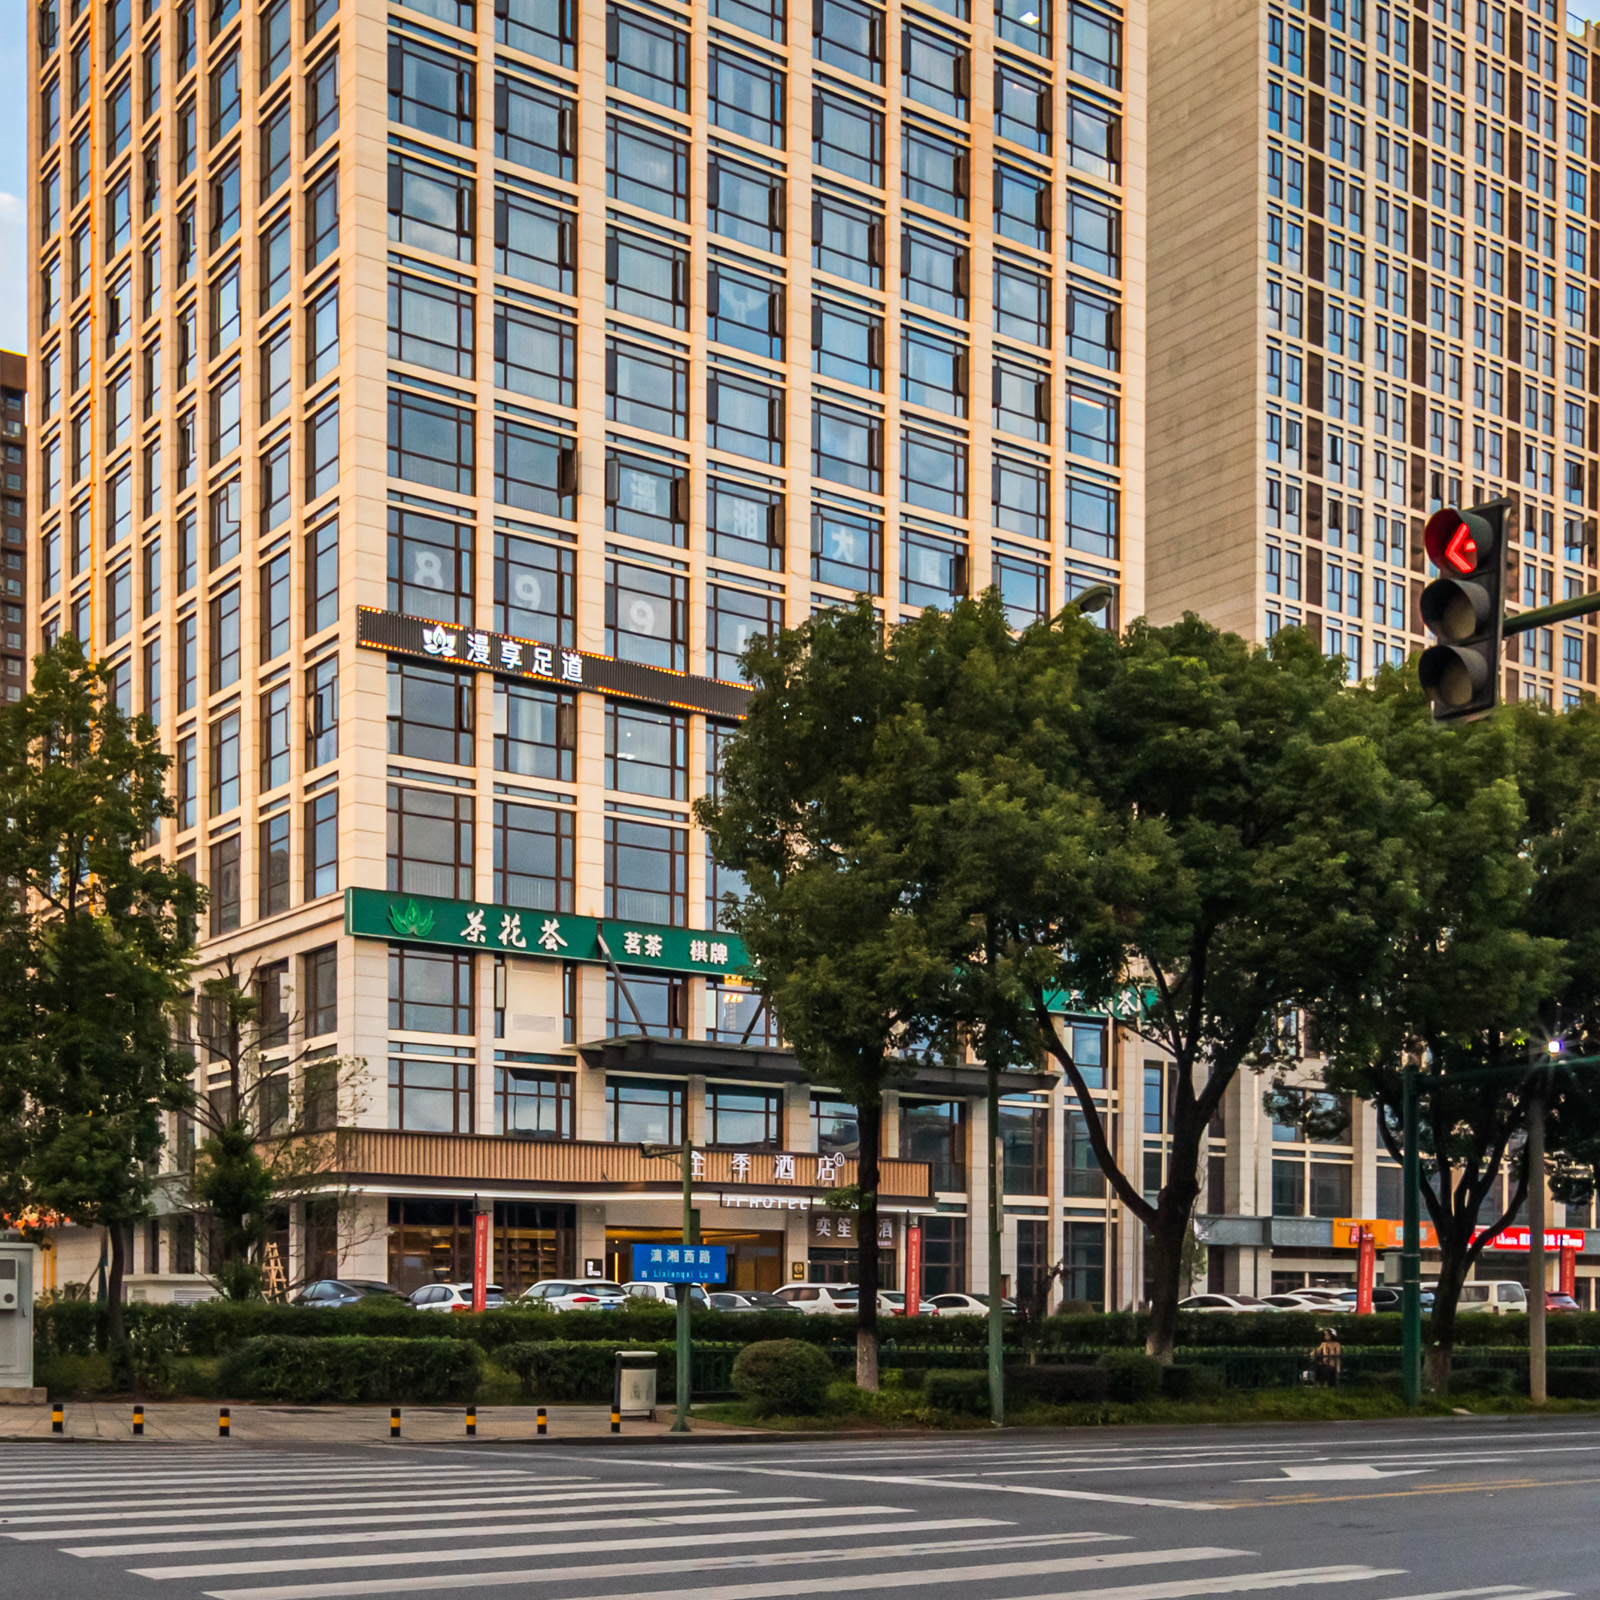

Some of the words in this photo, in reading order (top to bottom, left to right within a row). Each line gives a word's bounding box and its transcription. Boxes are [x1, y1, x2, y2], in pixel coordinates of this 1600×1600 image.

[467, 633, 583, 683] 漫享足道
[460, 908, 568, 951] 茶花荟
[623, 931, 663, 957] 茗茶
[689, 940, 729, 965] 棋牌
[691, 1151, 835, 1182] 全季酒店
[749, 1197, 808, 1210] HOTEL
